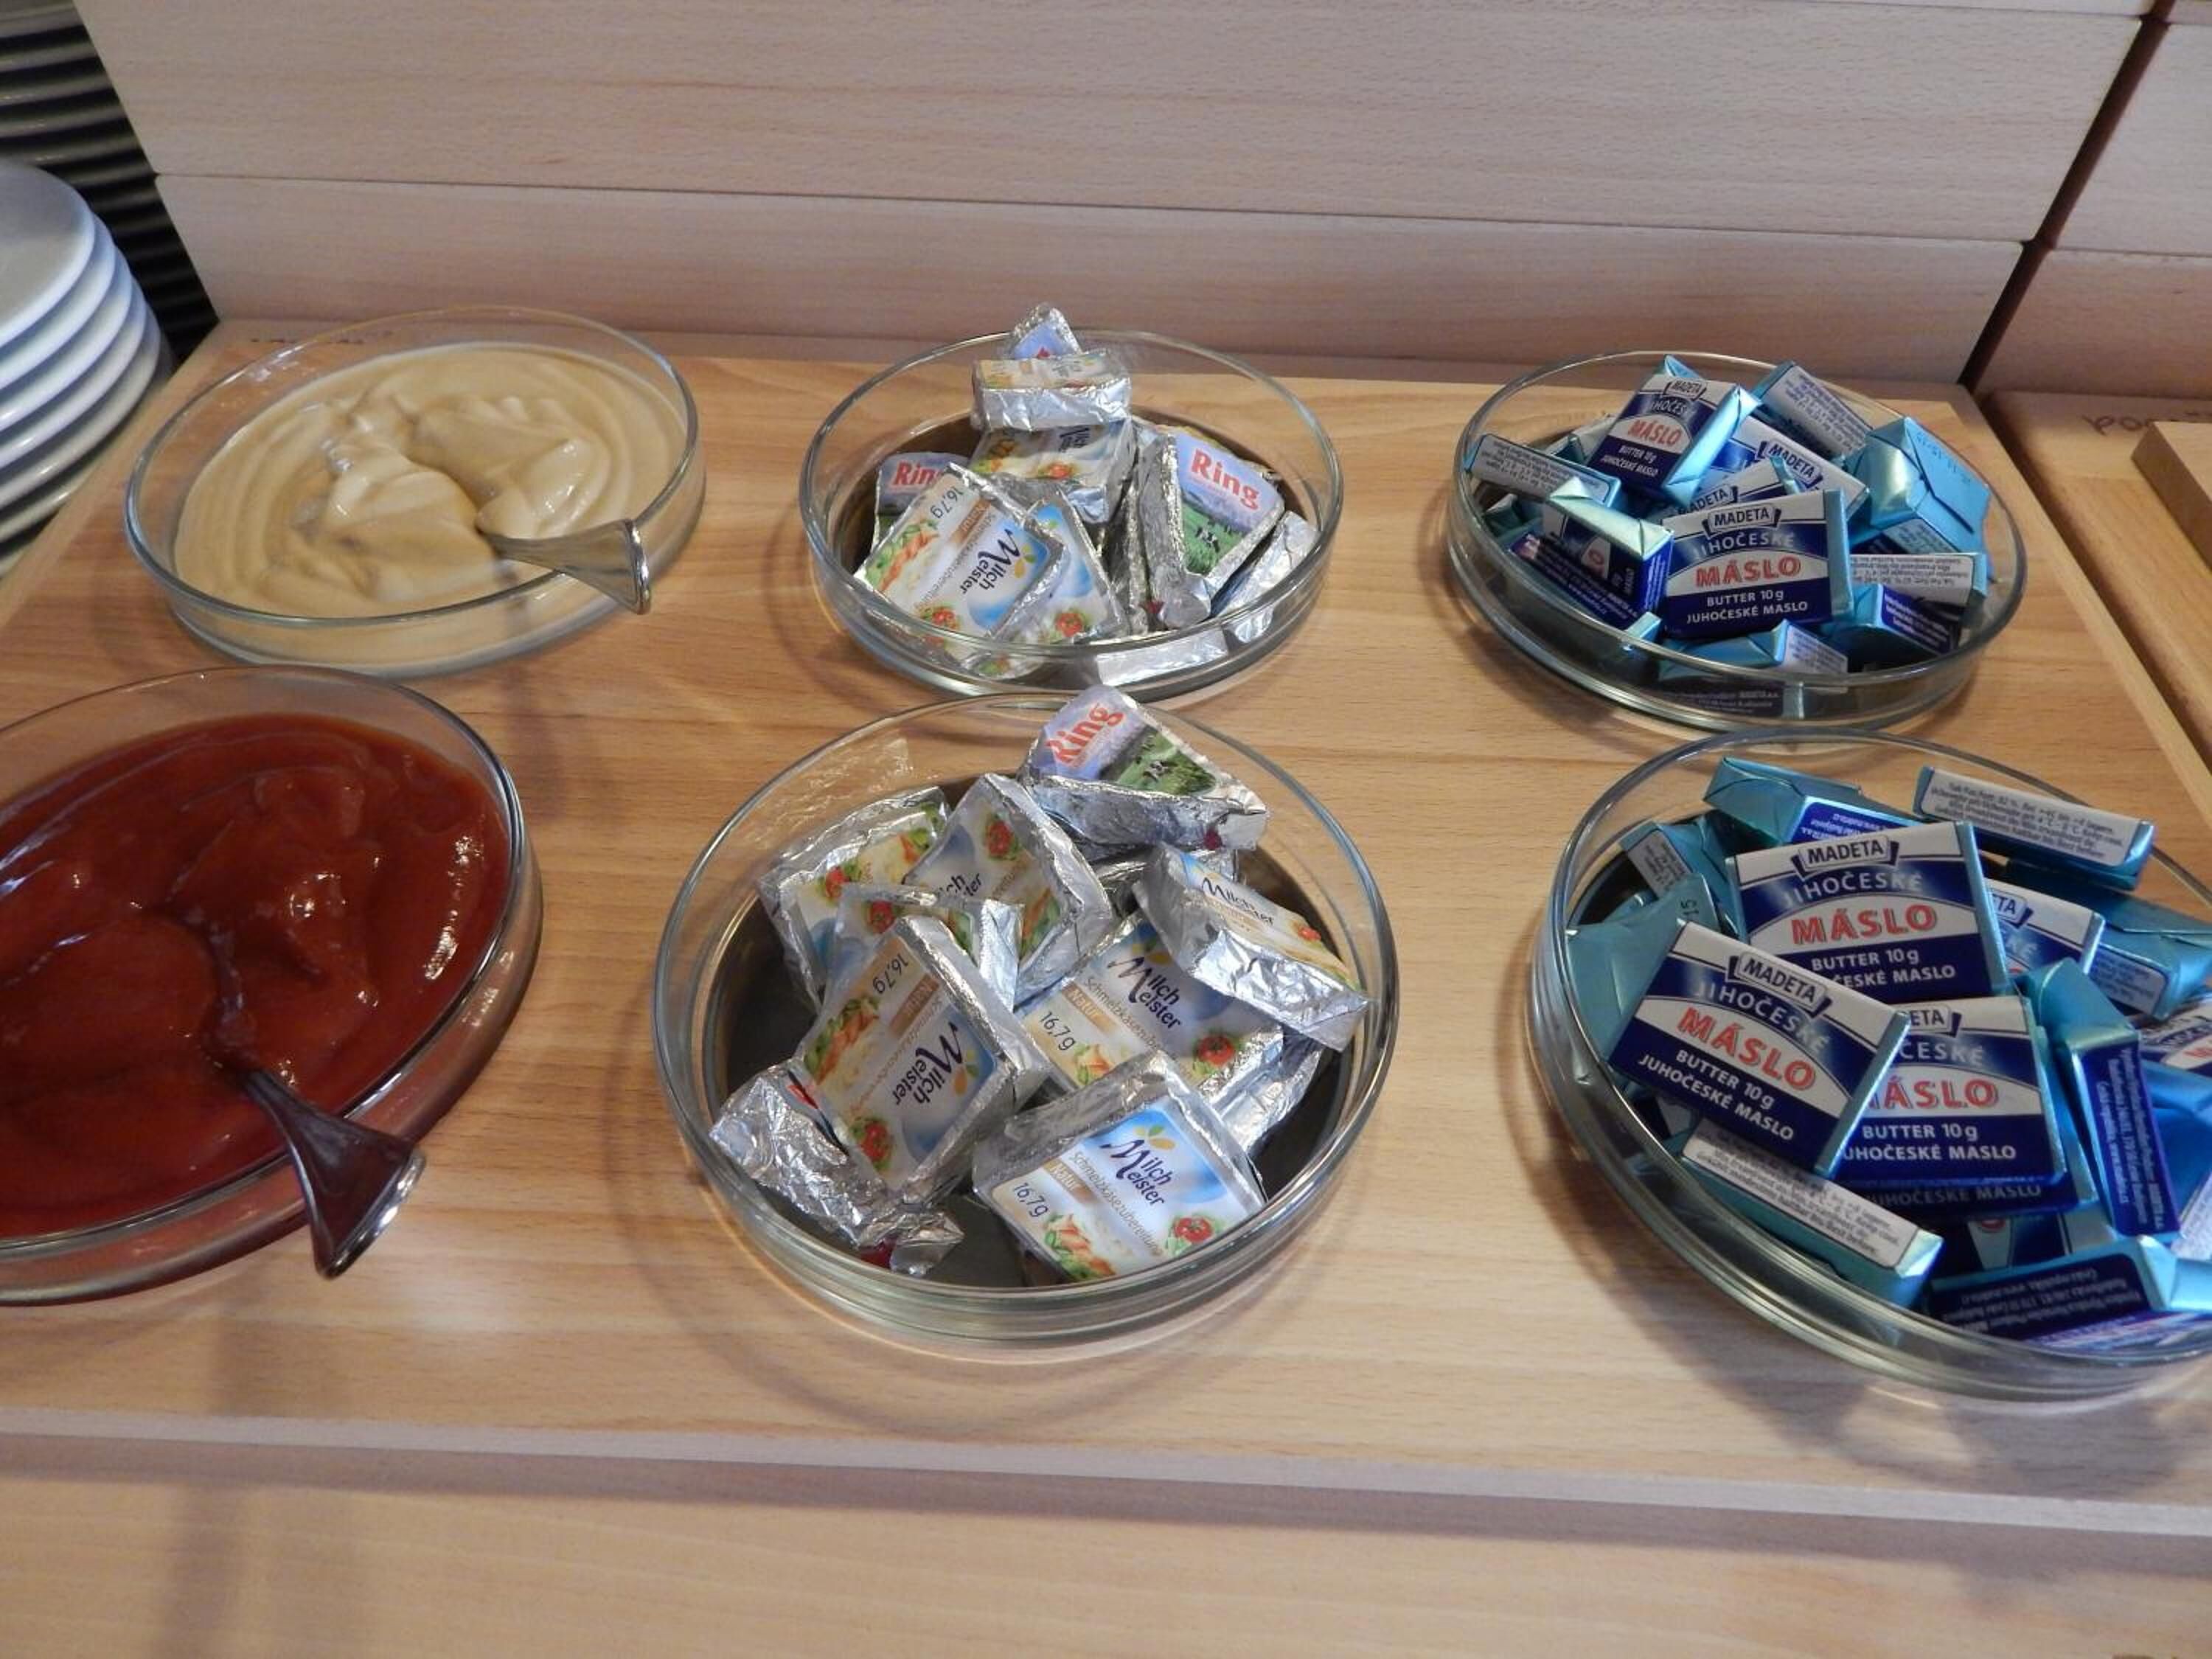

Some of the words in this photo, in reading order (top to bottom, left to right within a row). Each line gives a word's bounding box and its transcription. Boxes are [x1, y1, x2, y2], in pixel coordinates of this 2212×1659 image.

[1672, 379, 1703, 396] MADETA
[1627, 420, 1682, 446] MÁSLO
[892, 461, 941, 486] Rin
[1769, 443, 1815, 479] MADETA
[1190, 448, 1260, 511] Ring
[1714, 507, 1770, 527] MADETA
[1696, 554, 1802, 588] MÁSLO
[1686, 605, 1760, 625] JUHOČESKÉ
[1763, 600, 1809, 616] MASLO
[1706, 591, 1756, 608] BUTTER
[1044, 702, 1124, 764] Ring
[1807, 838, 1885, 866] MADETA
[1782, 871, 1924, 909] JIHOČESKÉ
[1790, 903, 1938, 946] MÁSLO
[1811, 950, 1881, 973] BUTTER
[1832, 967, 1888, 989] ČESKÉ
[1892, 964, 1958, 984] MASLO
[1107, 956, 1180, 1007] Milch
[1742, 957, 1818, 1004] MADETA
[1040, 1011, 1077, 1051] 16,7g
[1697, 981, 1829, 1055] JIHOČESKÉ
[1910, 1008, 1946, 1028] ETA
[1676, 1006, 1817, 1093] MÁSLO
[1897, 1038, 1986, 1066] ČESKÉ
[1675, 1048, 1740, 1091] BUTTER
[1638, 1053, 1736, 1108] JUHOČESKÉ
[1734, 1102, 1795, 1142] MASLO
[1862, 1124, 1936, 1141] BUTTER
[1099, 1138, 1173, 1188] Milch
[1843, 1144, 1943, 1162] UHOČESKÉ
[1948, 1144, 2017, 1161] MASLO
[1013, 1182, 1048, 1219] 16,7g
